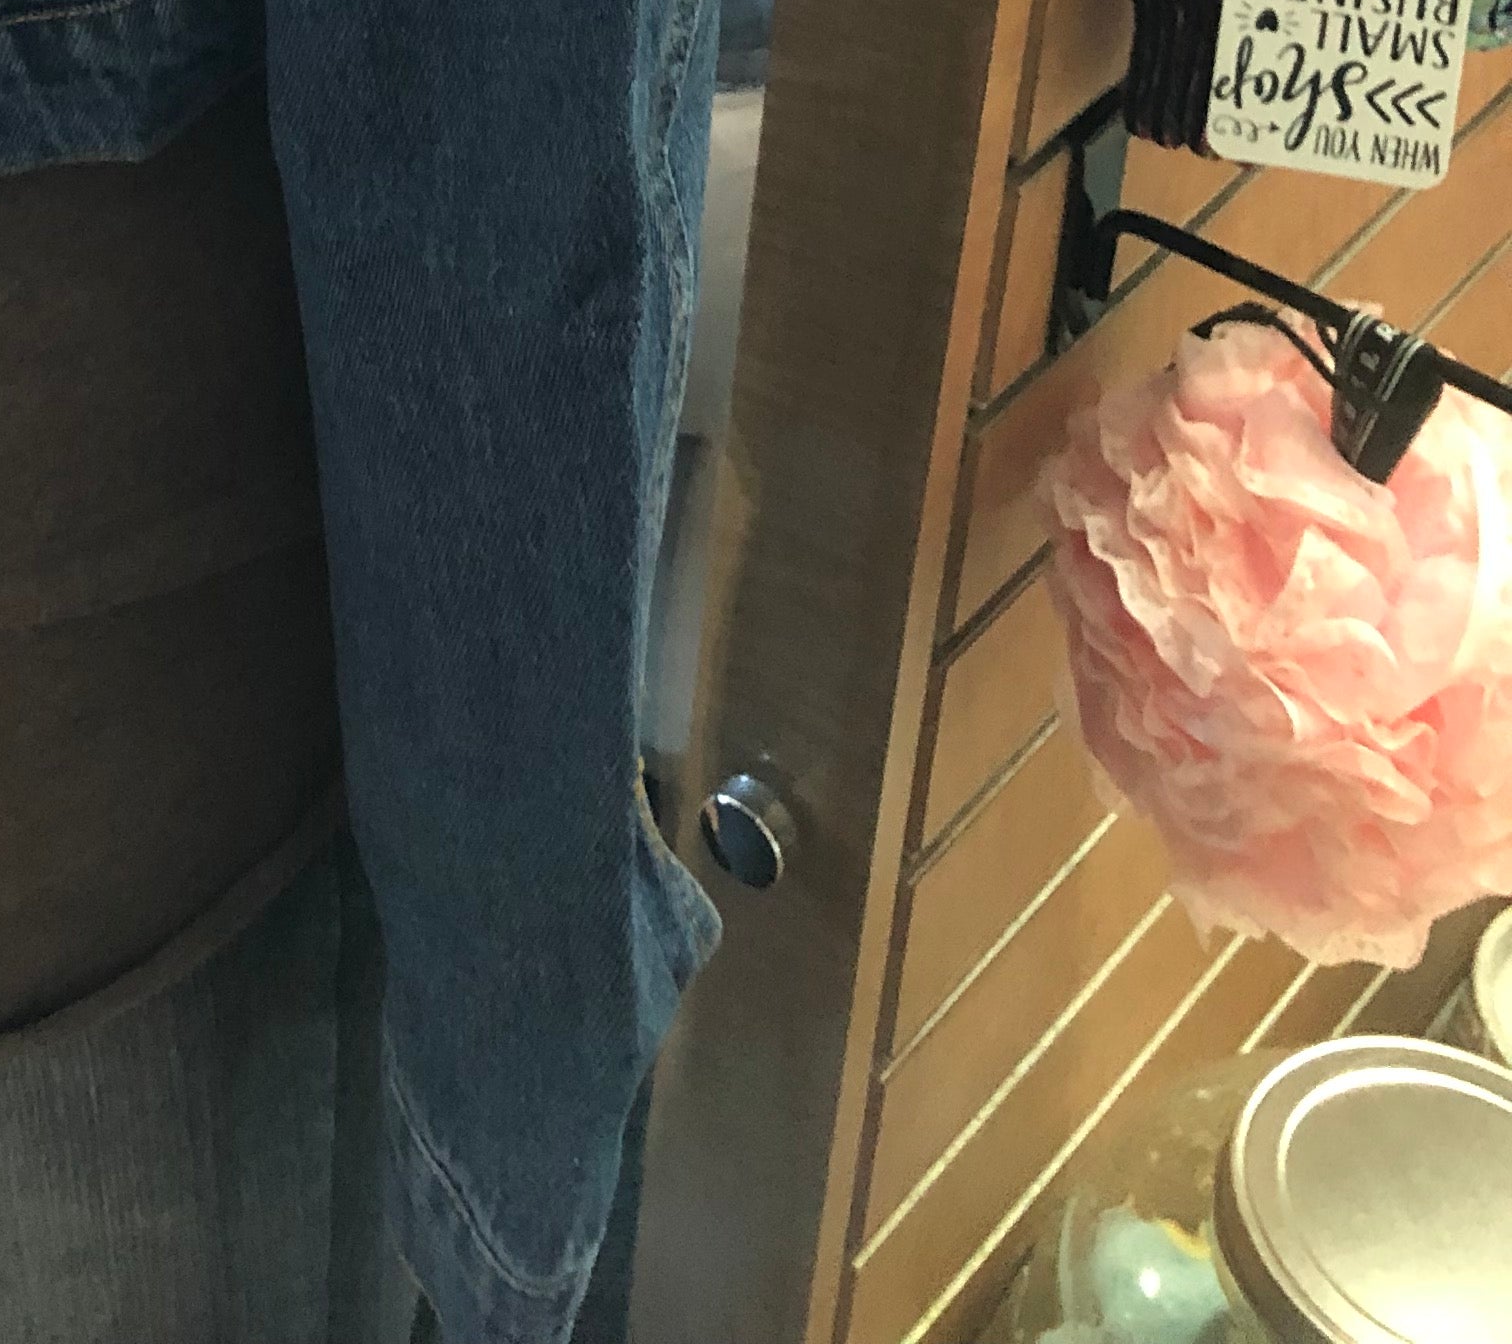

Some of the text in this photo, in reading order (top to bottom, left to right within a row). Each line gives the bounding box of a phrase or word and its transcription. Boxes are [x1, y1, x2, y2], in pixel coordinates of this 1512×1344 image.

[1310, 10, 1456, 70] SMALL
[1315, 123, 1440, 175] WHEN YOU
